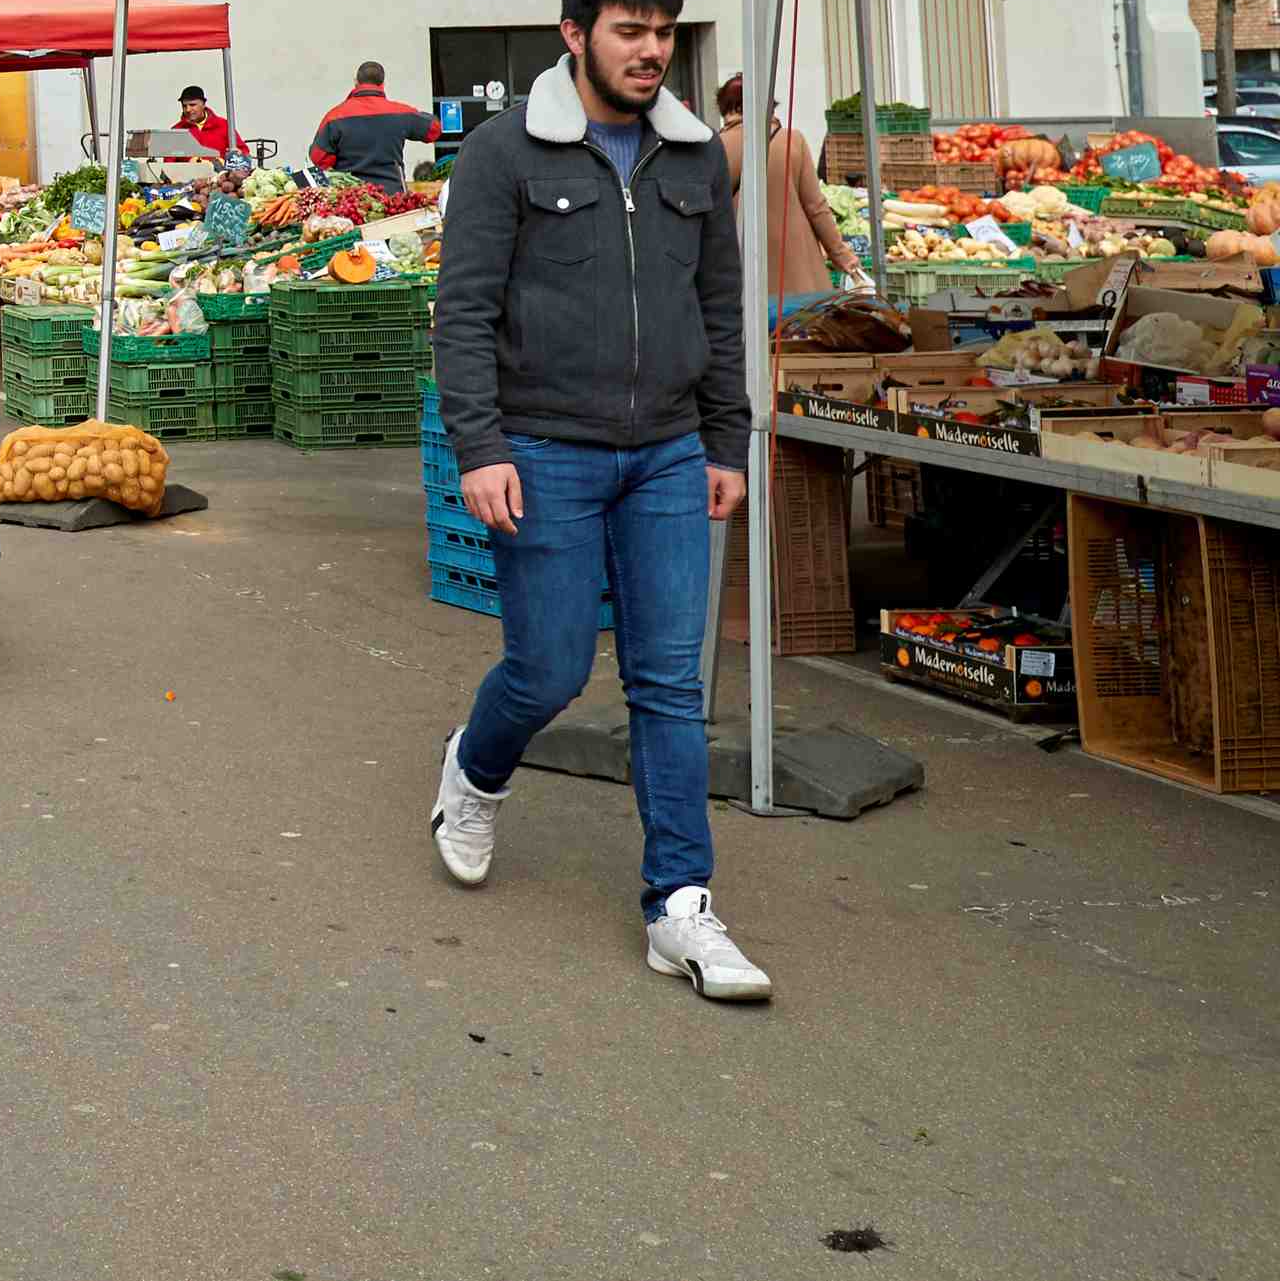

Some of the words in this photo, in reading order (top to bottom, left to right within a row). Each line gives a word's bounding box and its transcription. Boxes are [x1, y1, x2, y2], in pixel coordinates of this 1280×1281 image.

[808, 399, 879, 427] Mademoiselle
[935, 423, 1020, 453] Mademoiselle
[914, 646, 995, 687] Mademoiselle
